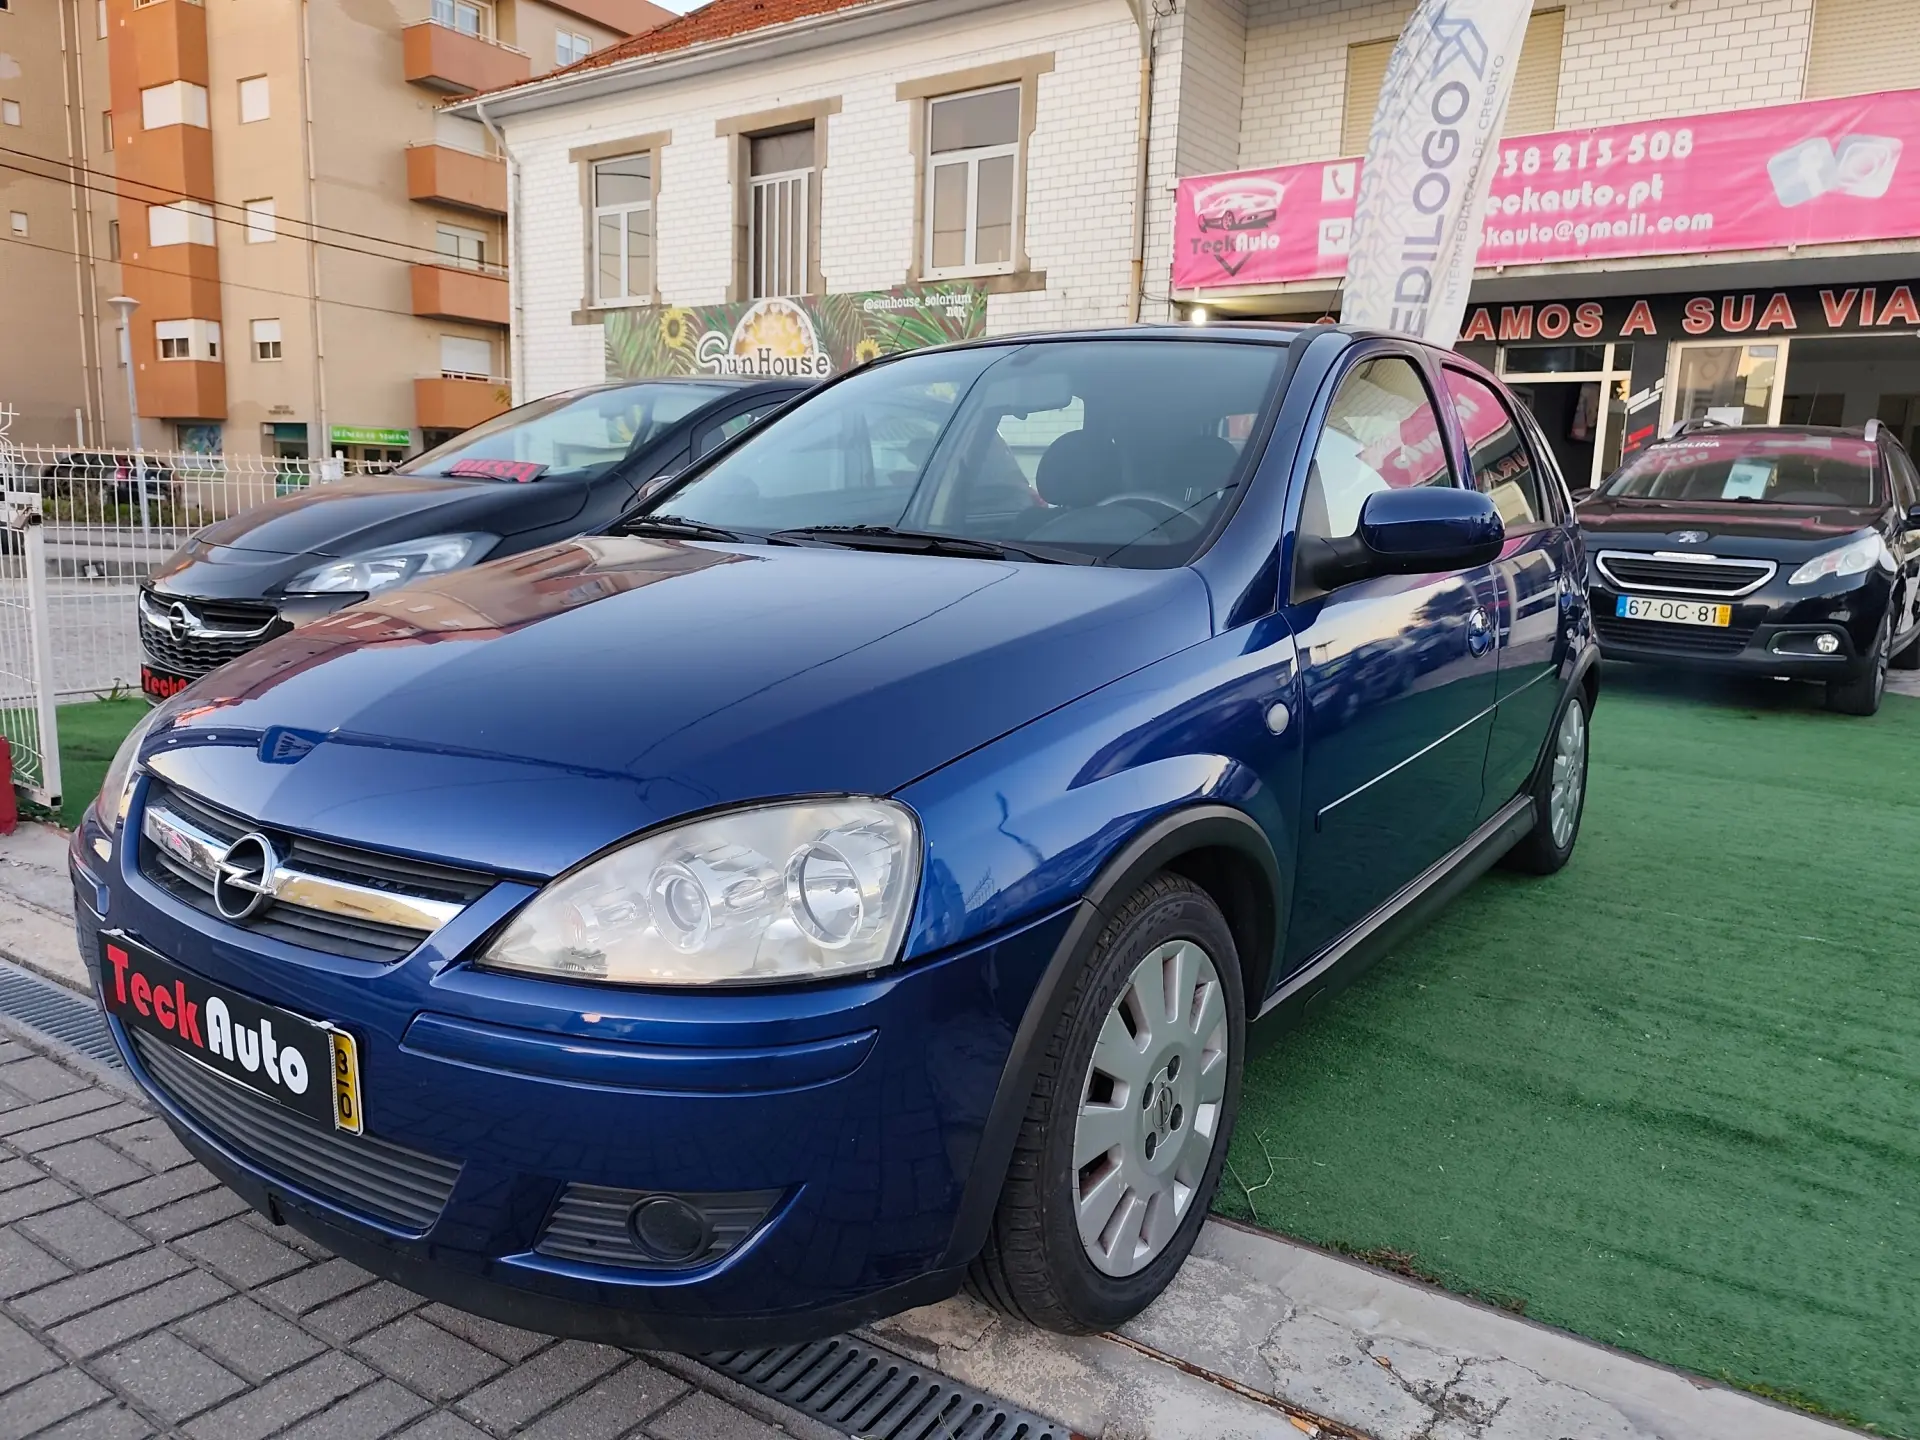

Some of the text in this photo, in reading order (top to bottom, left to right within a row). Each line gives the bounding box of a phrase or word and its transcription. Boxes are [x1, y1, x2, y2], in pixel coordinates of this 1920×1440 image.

[1495, 146, 1541, 177] 38
[1628, 128, 1693, 164] 508
[1485, 173, 1664, 215] eckauto.pt
[1190, 231, 1280, 255] TeckAuto
[1458, 285, 1920, 342] AMOS A SUA VIA
[697, 332, 830, 378] SunHouse
[106, 943, 310, 1095] TeckAuto
